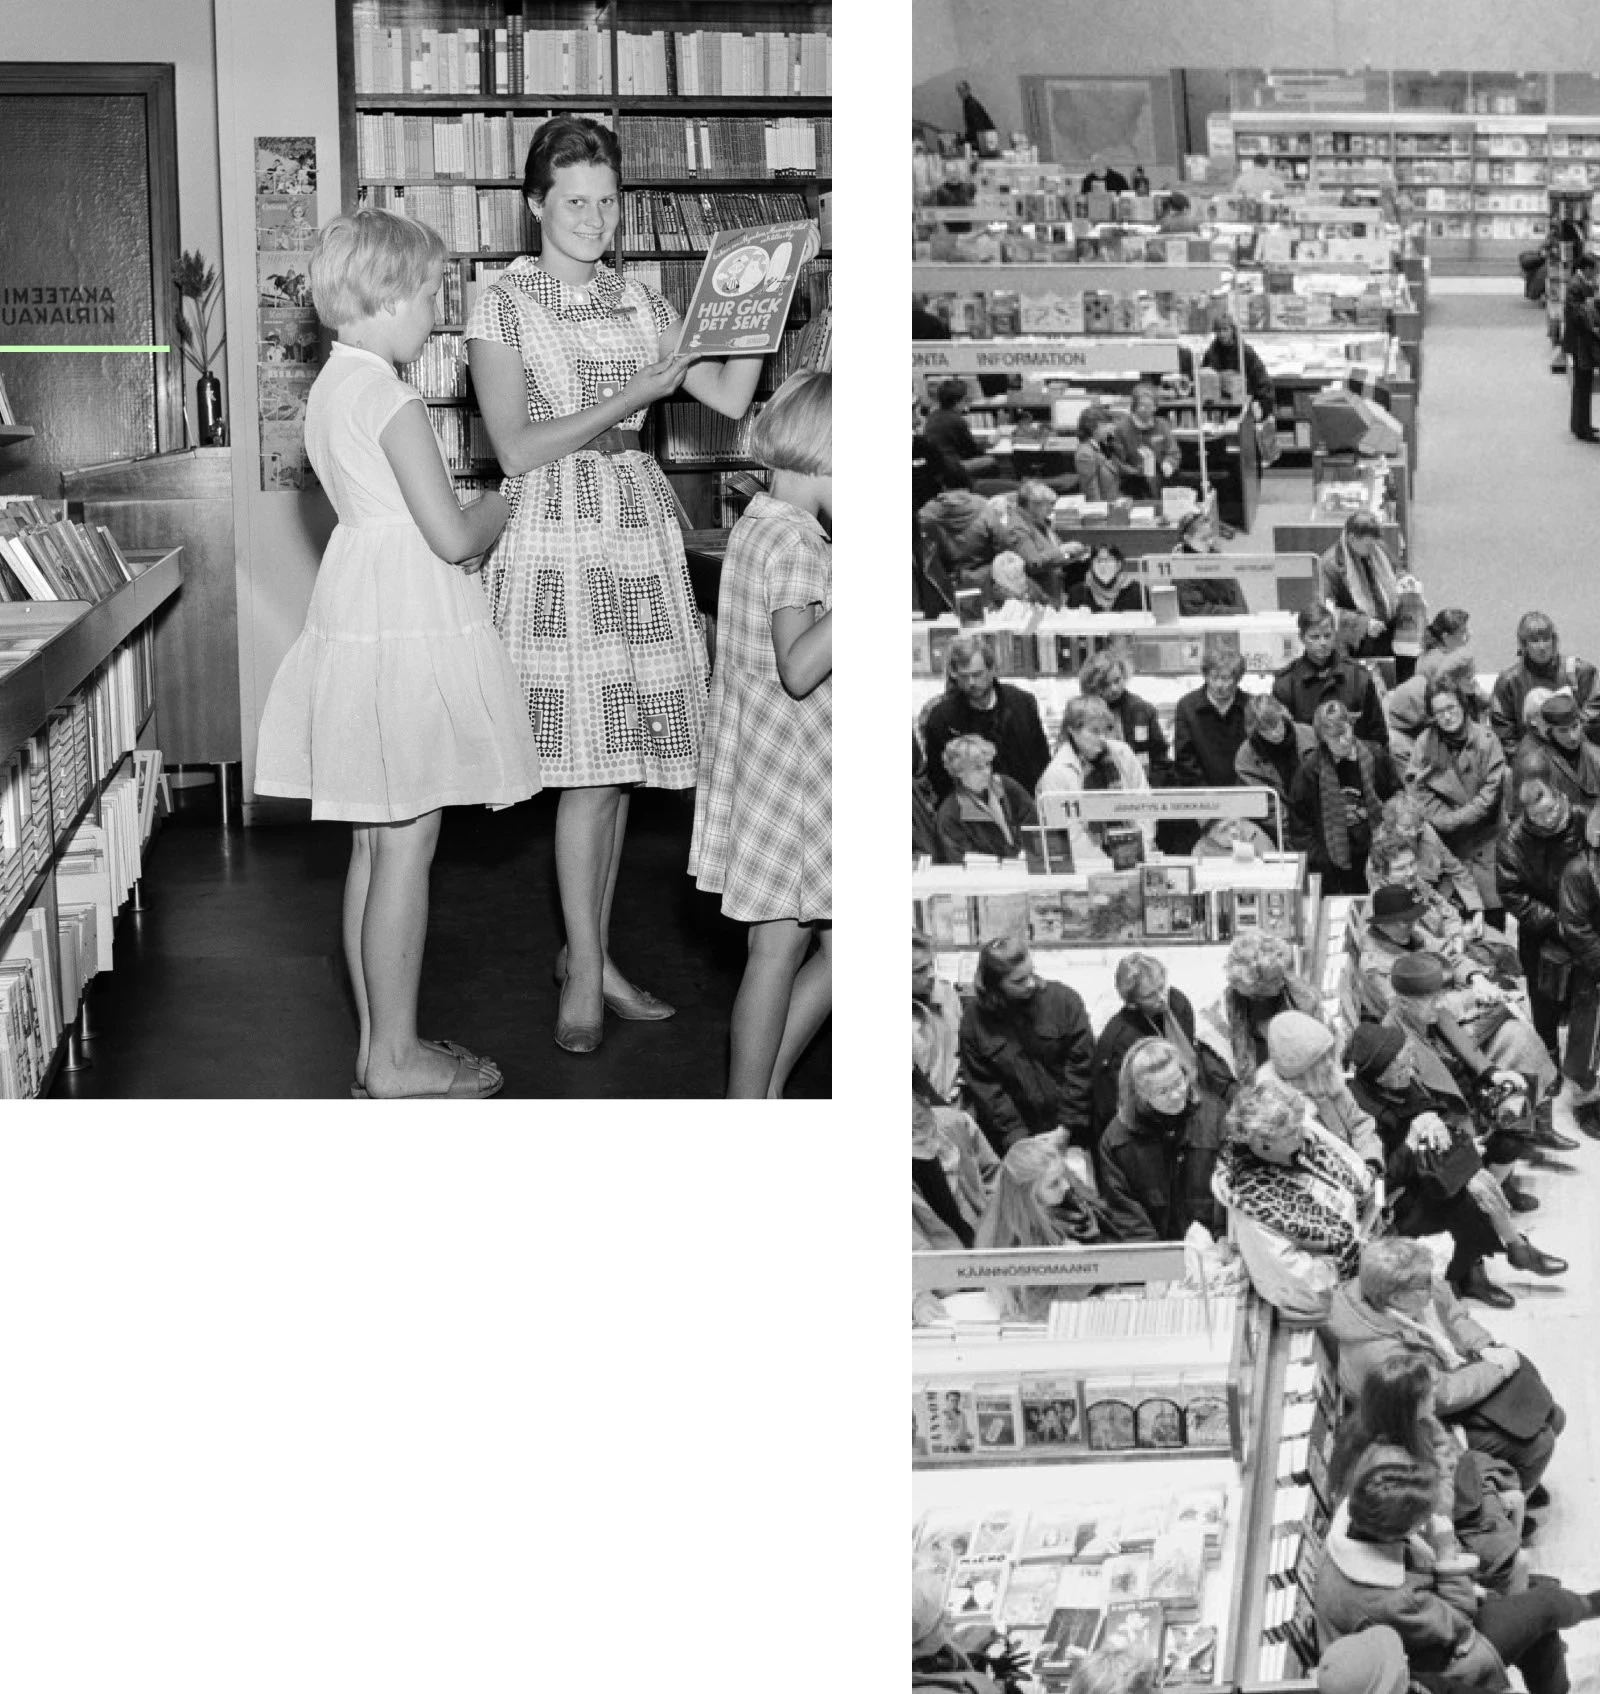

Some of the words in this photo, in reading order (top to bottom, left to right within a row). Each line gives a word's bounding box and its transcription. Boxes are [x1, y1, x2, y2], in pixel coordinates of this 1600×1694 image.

[697, 300, 736, 319] HUR
[737, 298, 782, 316] GICK
[699, 317, 729, 332] DET
[731, 313, 772, 331] SEN?
[976, 351, 1087, 368] INFORMATION
[1157, 561, 1171, 577] 11
[1060, 799, 1080, 818] 11
